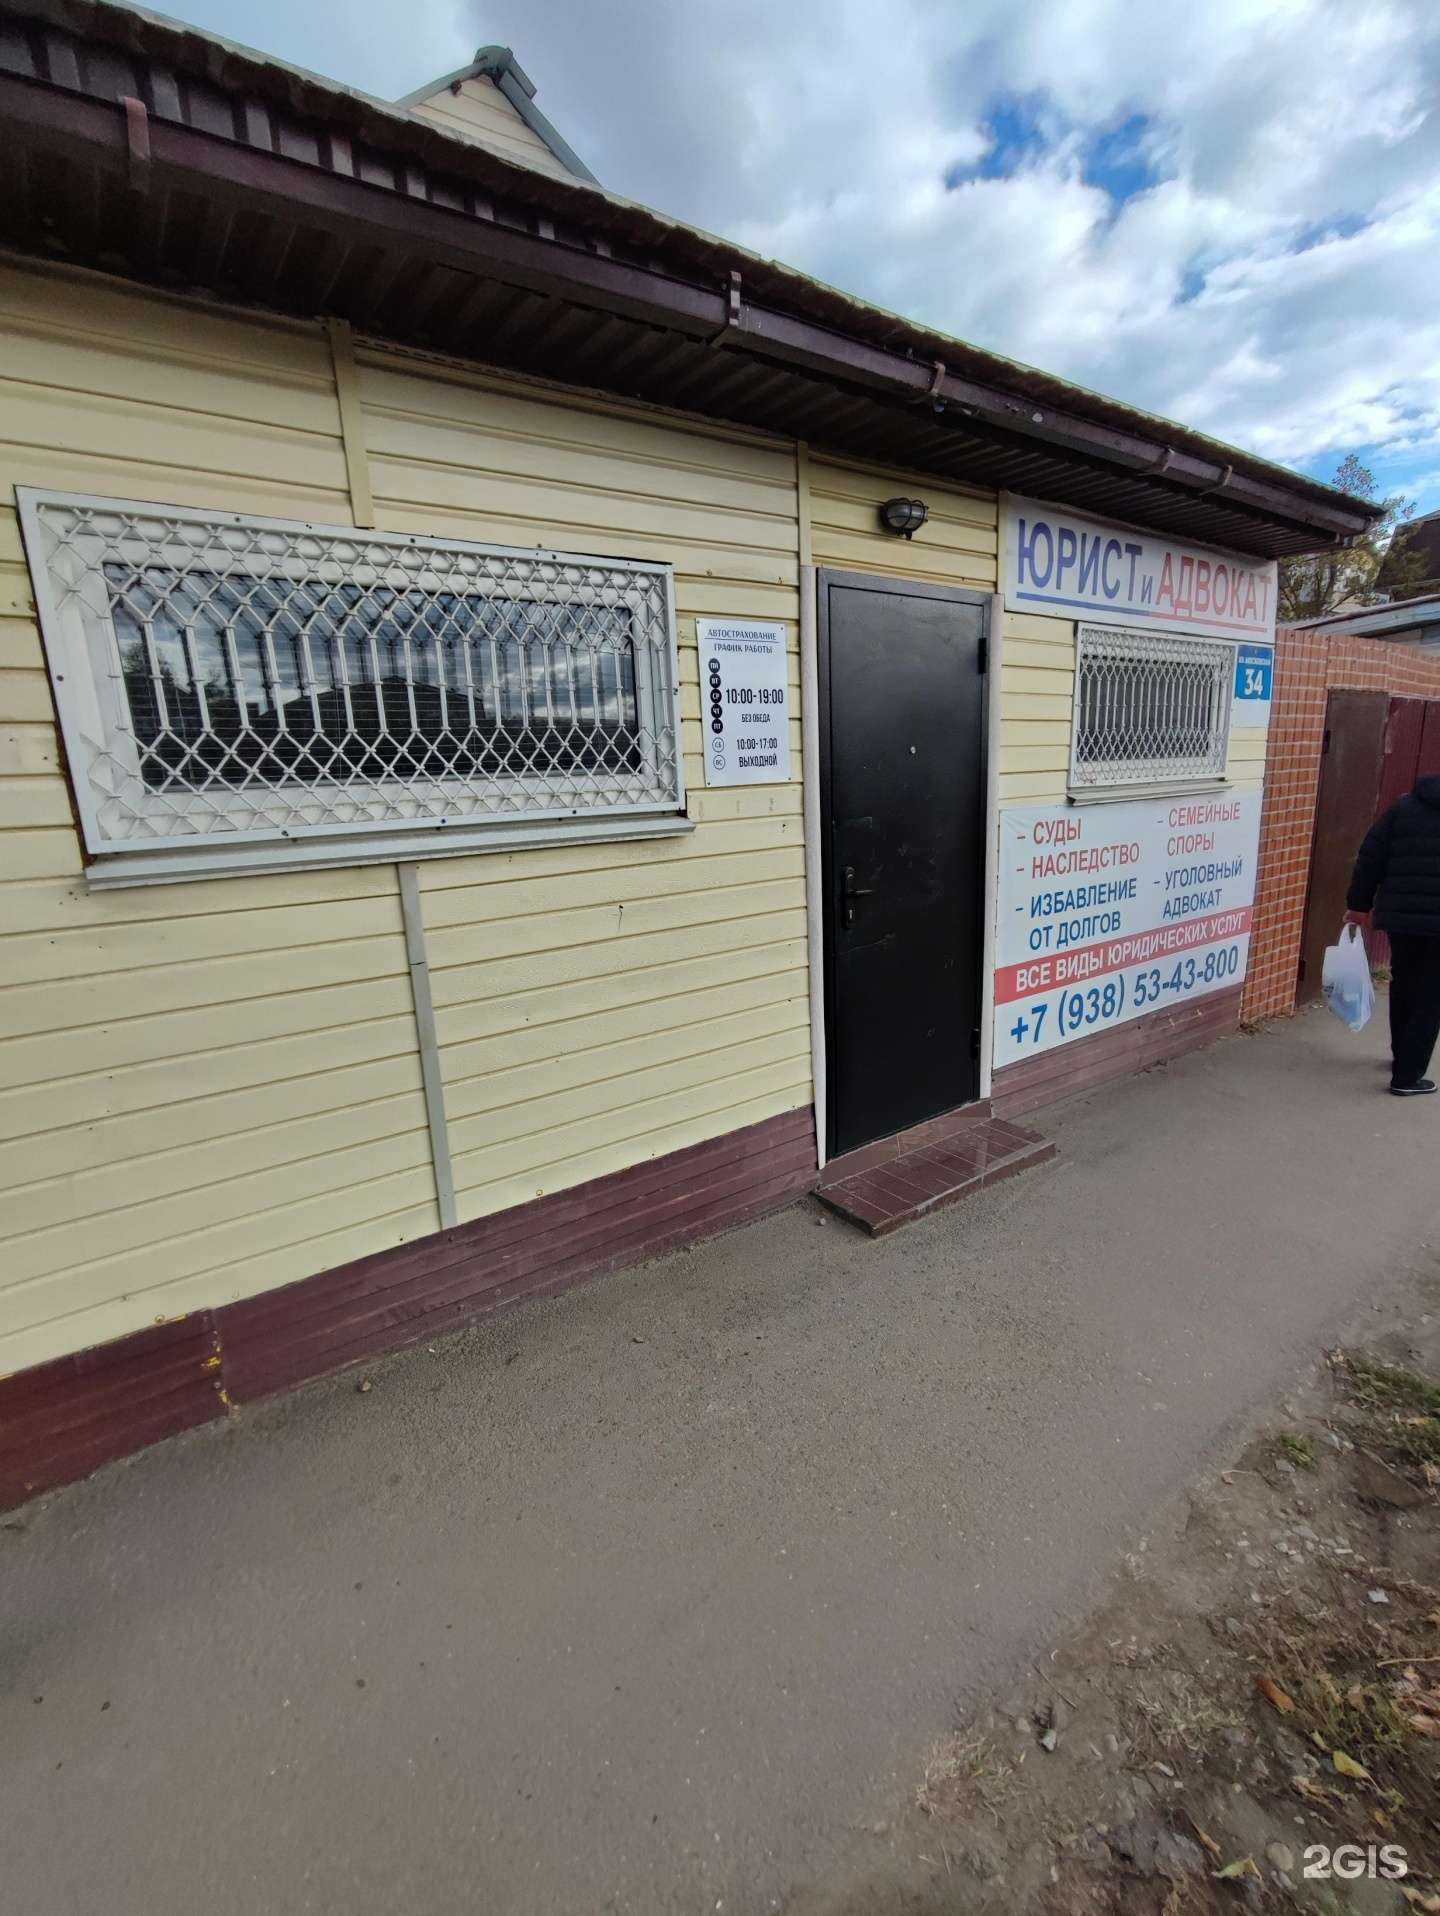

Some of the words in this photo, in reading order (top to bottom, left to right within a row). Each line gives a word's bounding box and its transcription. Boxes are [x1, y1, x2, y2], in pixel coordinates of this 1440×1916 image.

[1018, 518, 1143, 600] ЮРИСТ
[1141, 574, 1154, 605] и
[1156, 552, 1272, 622] АДВОКАТ
[707, 629, 777, 641] АВТОСТРАХОВАНИЕ
[714, 642, 744, 653] ГРАФИК
[744, 644, 773, 654] РАБОТЫ
[1244, 668, 1264, 696] 34
[741, 713, 752, 723] БЕЗ
[752, 713, 771, 723] ОБЕДА
[738, 753, 778, 768] ВЫХОДНОЙ
[1168, 801, 1241, 828] СЕМЕЙНЫЕ
[1033, 818, 1081, 847] СУДЫ
[1167, 832, 1215, 857] СПОРЫ
[1031, 843, 1140, 879] НАСЛЕДСТВО
[1165, 855, 1243, 891] УГОЛОВНЫЙ
[1030, 877, 1138, 919] ИЗБАВЛЕНИЕ
[1163, 888, 1222, 920] АДВОКАТ
[1029, 925, 1056, 950] ОТ
[1056, 910, 1121, 949] ДОЛГОВ
[1015, 962, 1051, 992] ВСЕ
[1055, 950, 1103, 980] ВИДЫ
[1107, 920, 1208, 965] ЮРИДИЧЕСКИХ
[1209, 911, 1246, 938] УСЛУГ
[1010, 1003, 1048, 1043] +7
[1058, 974, 1125, 1036] (938)
[1133, 945, 1239, 1007] 53-43-800
